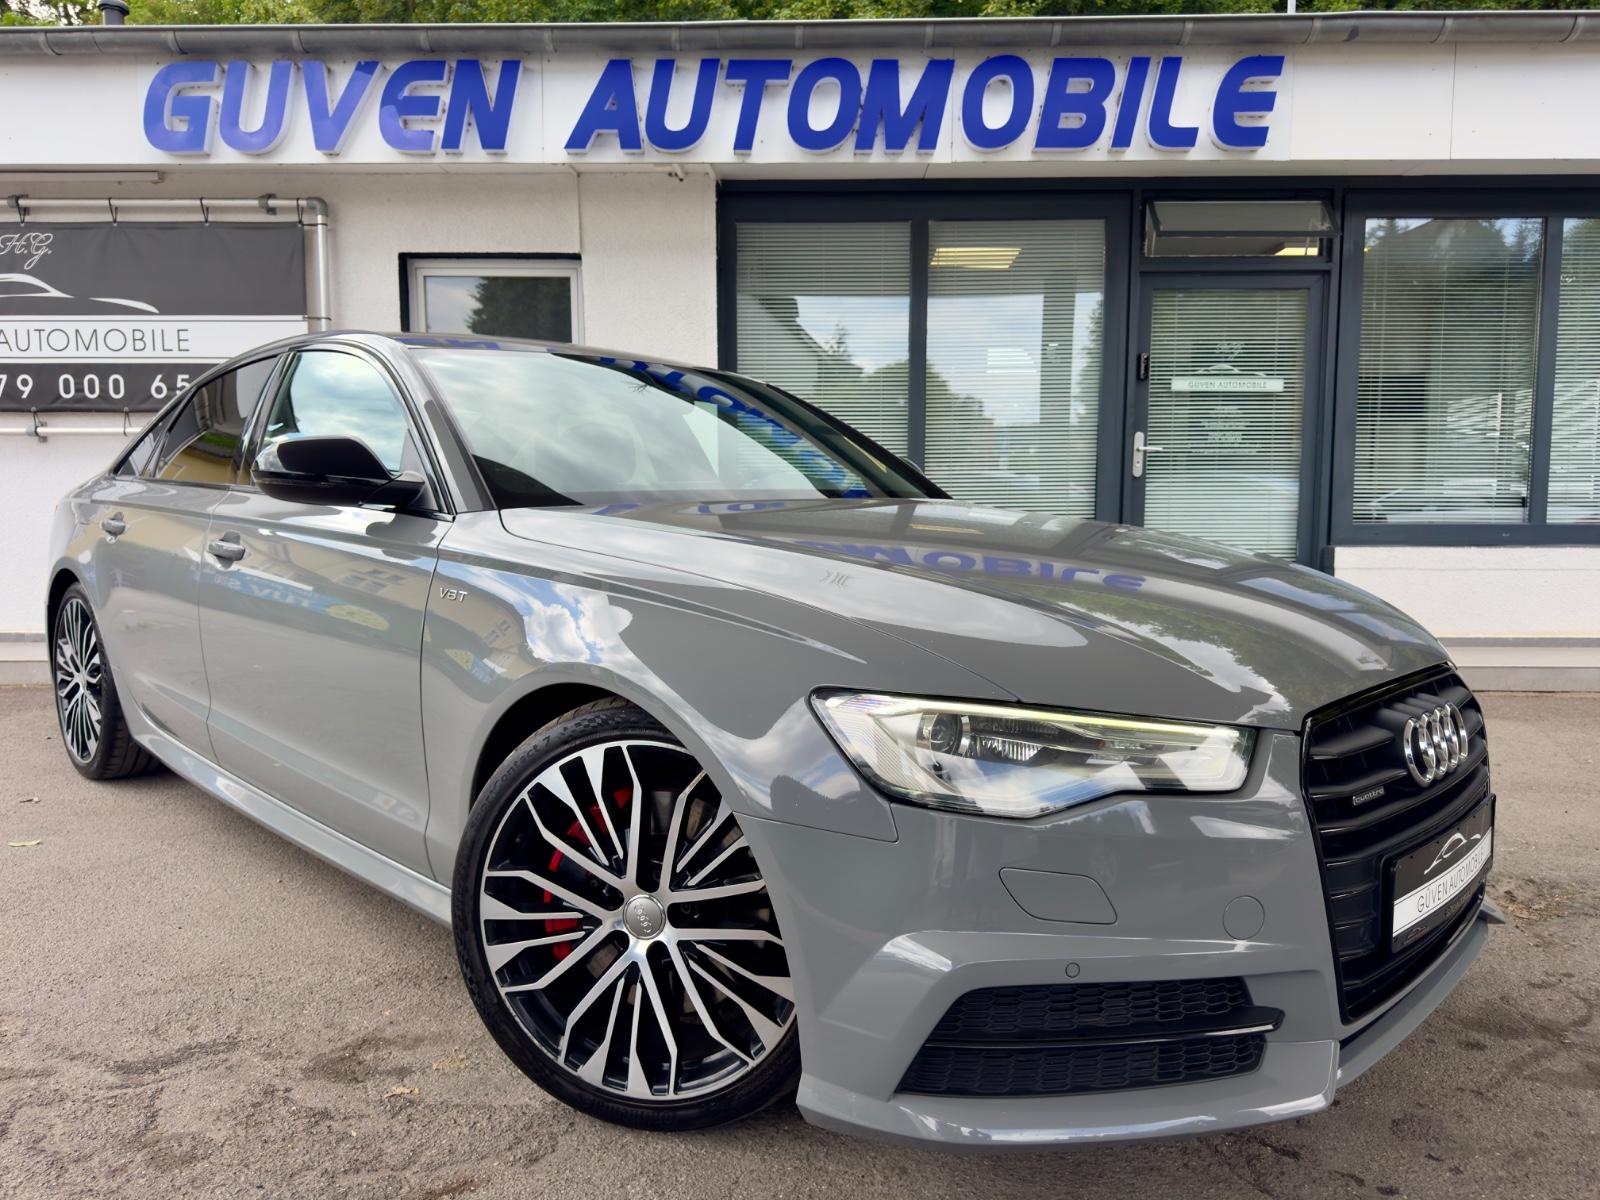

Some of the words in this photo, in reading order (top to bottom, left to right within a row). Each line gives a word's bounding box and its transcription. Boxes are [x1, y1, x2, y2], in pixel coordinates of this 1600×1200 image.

[143, 59, 523, 155] GUVEN
[565, 55, 1285, 155] AUTOMOBILE
[58, 373, 125, 399] 000
